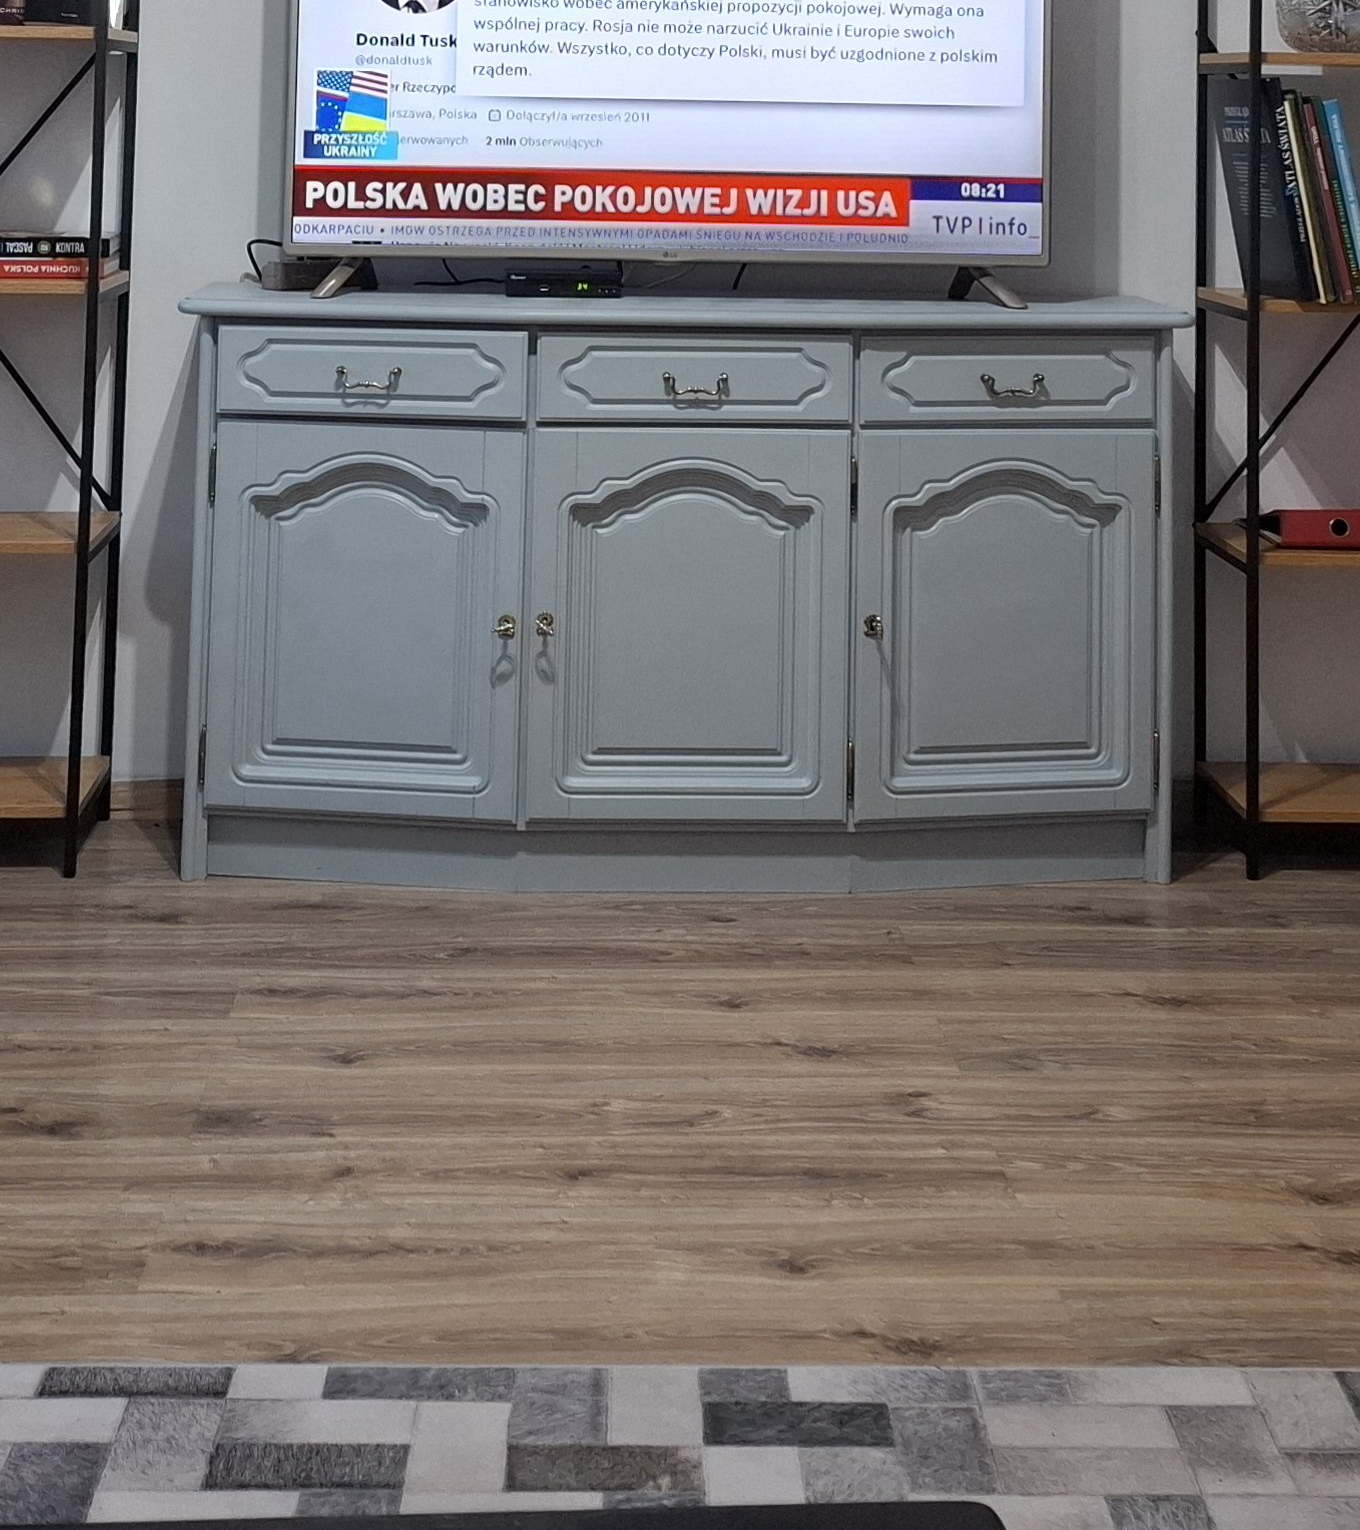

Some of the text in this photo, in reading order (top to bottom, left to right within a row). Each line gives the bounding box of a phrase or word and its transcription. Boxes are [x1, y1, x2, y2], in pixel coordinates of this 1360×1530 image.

[727, 0, 802, 16] propozycji
[806, 1, 886, 17] pokojowej.
[889, 2, 953, 19] Wymaga
[957, 6, 984, 17] ona
[473, 17, 540, 33] wspólnej
[544, 20, 588, 33] pracy.
[593, 19, 633, 34] Rosja
[637, 20, 659, 33] nie
[663, 20, 703, 34] może
[706, 21, 768, 36] narzucić
[772, 22, 833, 37] Ukrainie
[844, 24, 900, 40] Europie
[903, 25, 955, 40] swoich
[356, 33, 457, 48] Donald Tusk
[473, 40, 998, 63] warunków. Wszystko, co dotyczy Polski, musi być uzgodnione z polskim
[355, 54, 433, 67] @donaldtusk
[472, 63, 532, 78] rządem.
[439, 108, 478, 120] Polska
[624, 112, 650, 123] 2011
[313, 131, 388, 145] PRZYSZŁOŚĆ
[485, 135, 493, 147] 2
[495, 136, 517, 147] mln
[323, 145, 378, 158] UKRAINY
[960, 182, 1005, 199] 08:21
[305, 180, 898, 218] POLSKA WOBEC POKOJOWEJ WIZJI USA
[294, 223, 374, 235] ODKARPACIU
[428, 225, 491, 236] OSTRZEGA
[496, 226, 535, 238] PRZED
[540, 226, 633, 239] INTENSYWNYMI
[637, 228, 692, 240] OPADAMI
[696, 228, 740, 241] ŚNIEGU
[744, 229, 761, 241] NA
[765, 230, 835, 242] WSCHODZIE
[933, 215, 973, 235] TVP
[6, 241, 33, 253] PASCAL
[55, 242, 85, 253] KONTRA
[3, 264, 39, 273] POLSKA
[41, 264, 80, 273] KUCHNIA
